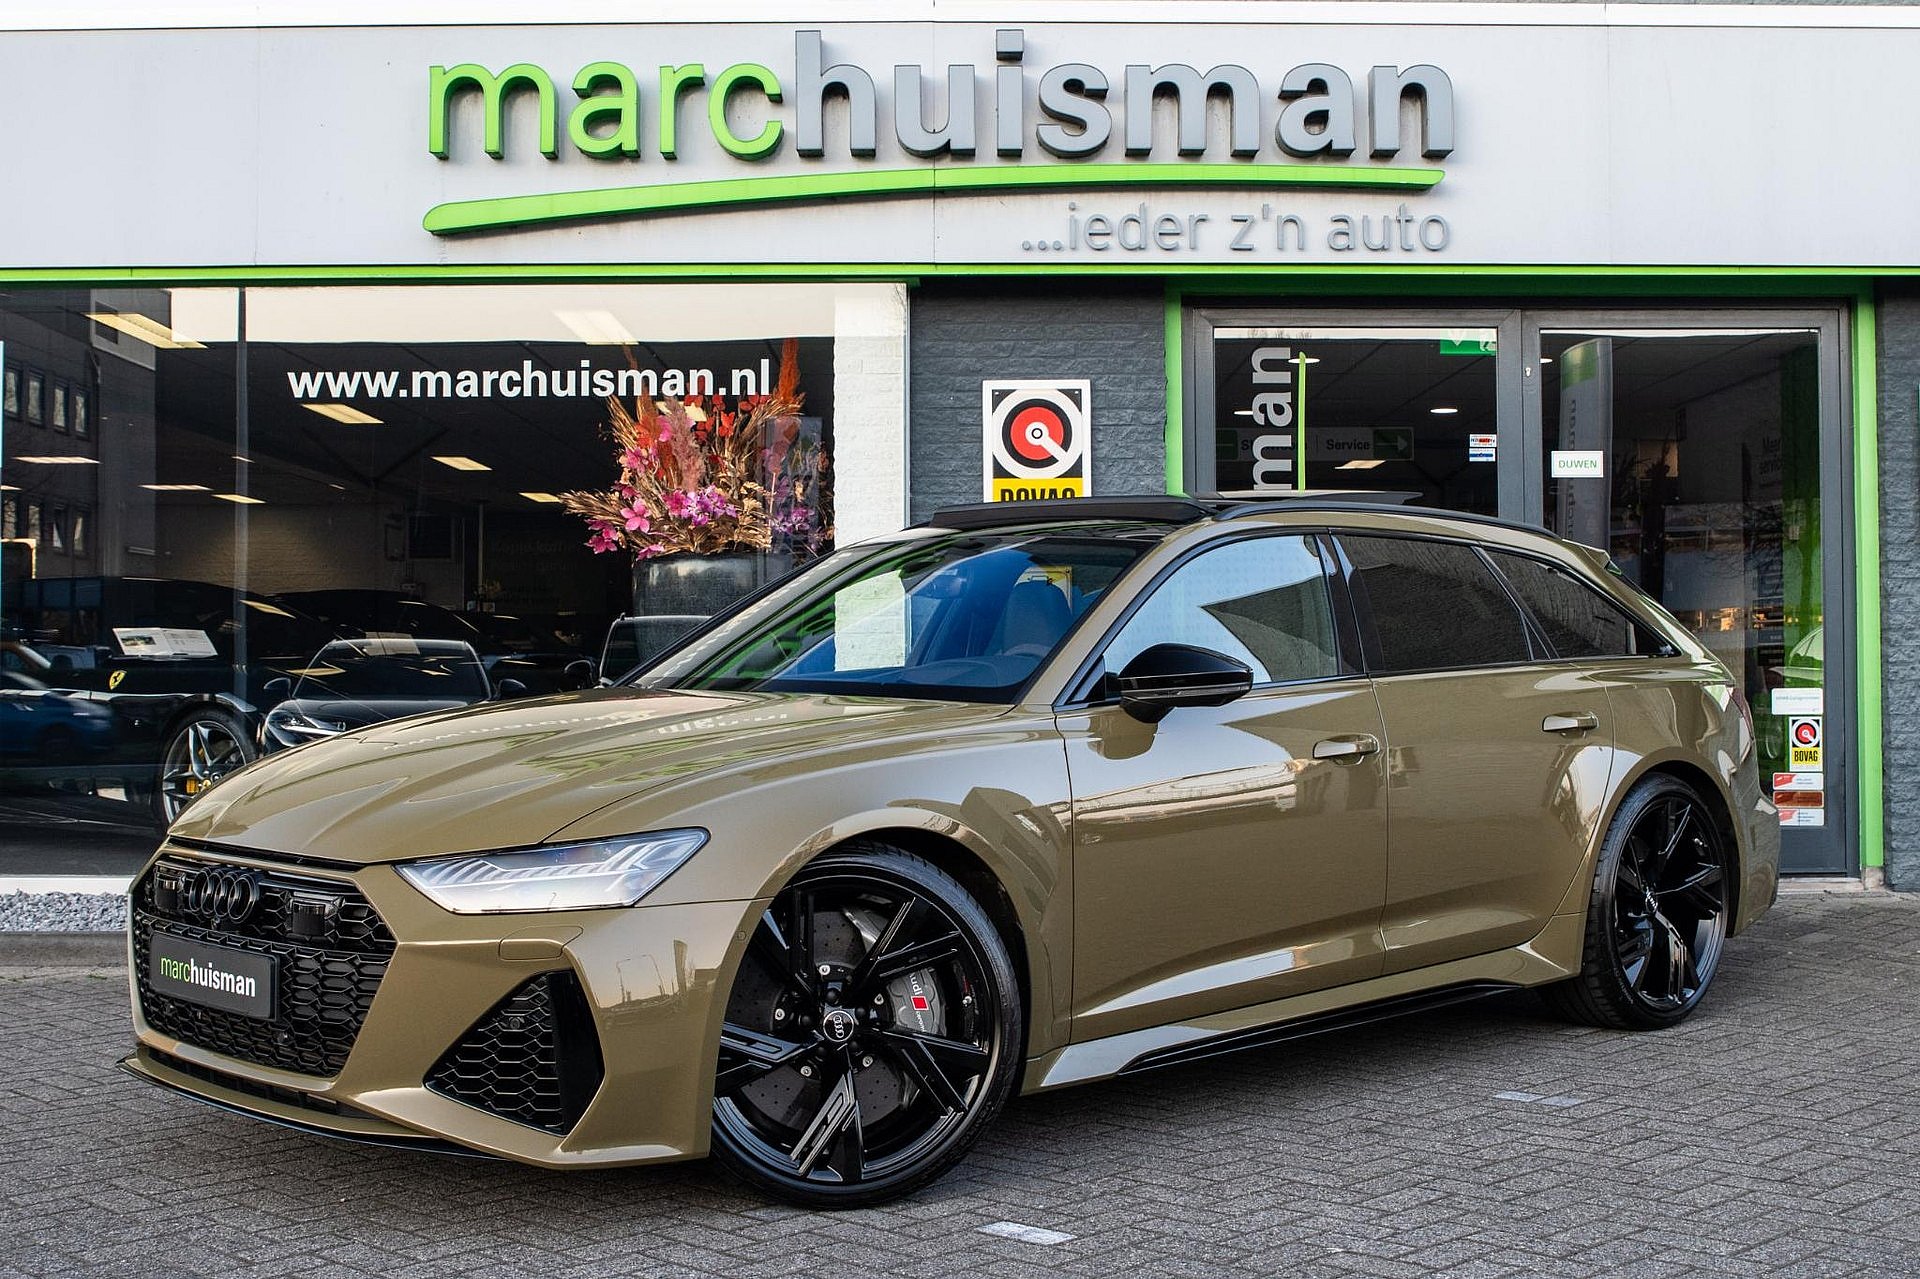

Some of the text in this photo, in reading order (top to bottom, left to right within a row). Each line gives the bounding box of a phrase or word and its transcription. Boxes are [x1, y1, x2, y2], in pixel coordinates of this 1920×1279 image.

[428, 30, 1454, 159] marchuisman
[1230, 203, 1305, 252] z'n
[1327, 203, 1451, 252] auto
[287, 358, 770, 399] www.marchuisman.nl
[1558, 459, 1598, 470] DUWEN
[1794, 750, 1818, 762] BOVAG
[160, 957, 256, 997] marchuisman
